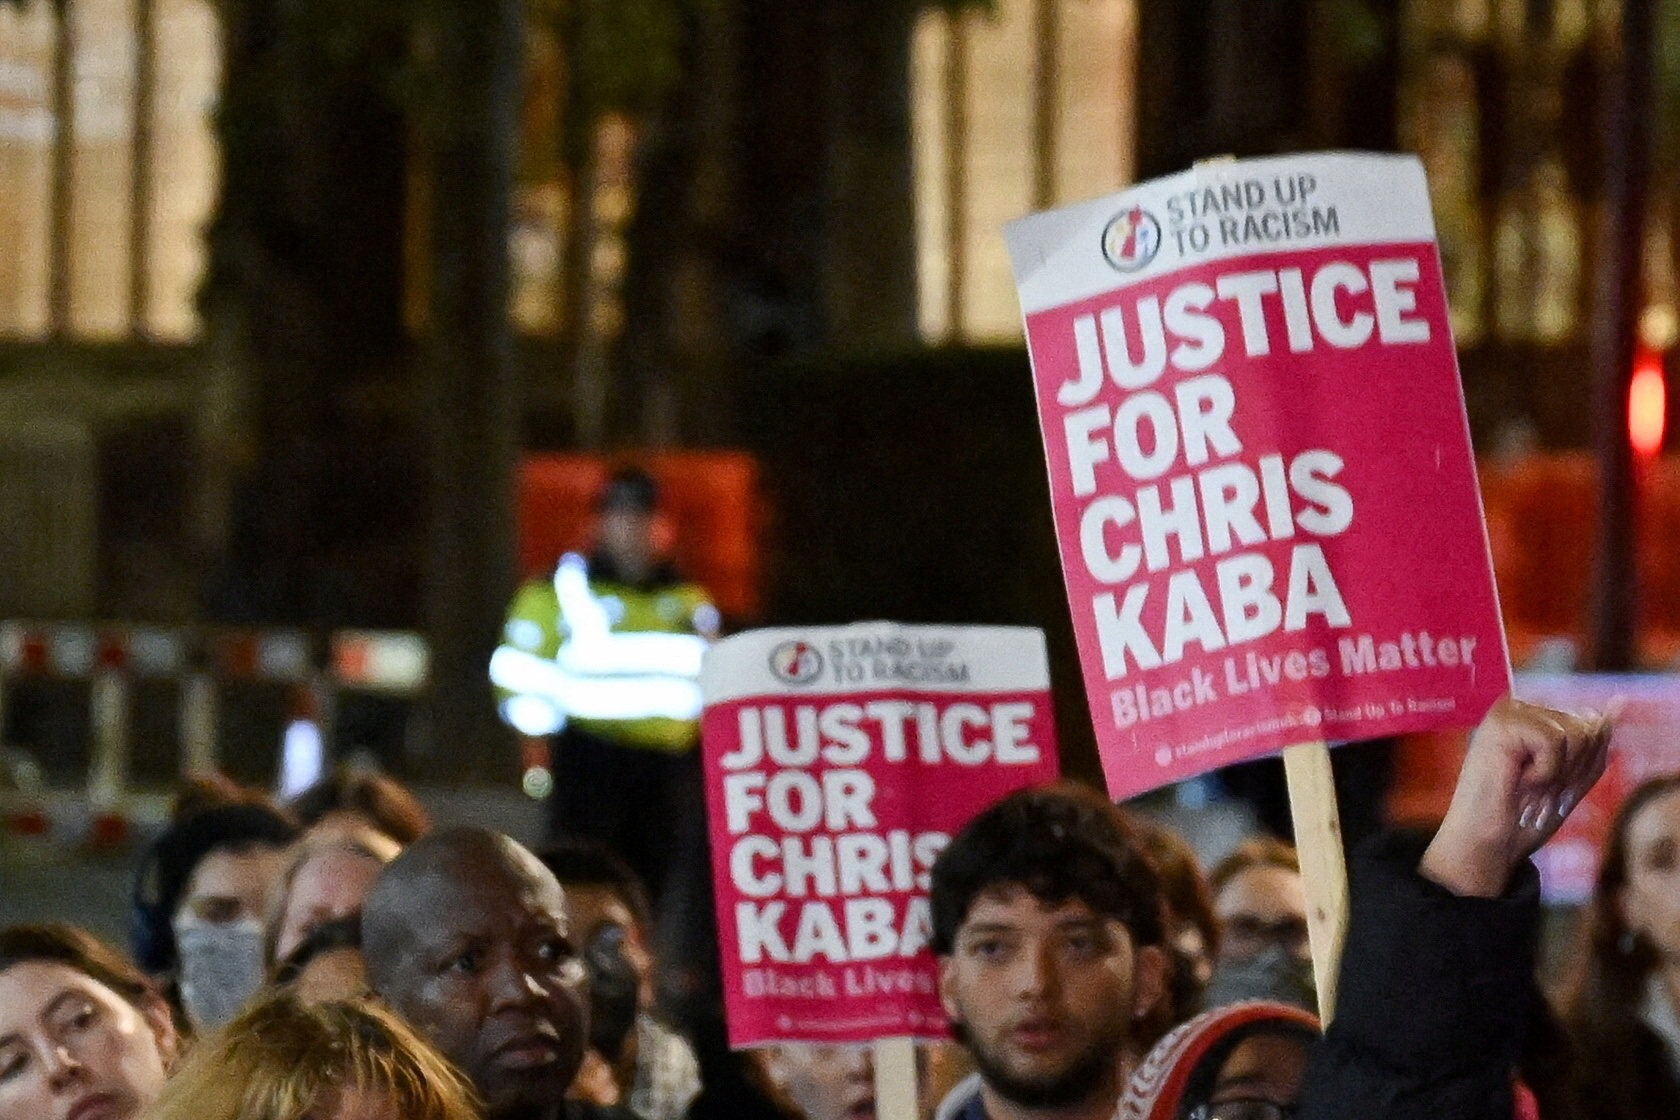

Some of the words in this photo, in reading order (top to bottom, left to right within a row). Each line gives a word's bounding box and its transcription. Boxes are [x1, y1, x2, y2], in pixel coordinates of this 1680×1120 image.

[1167, 178, 1265, 223] STAND
[1274, 172, 1317, 206] UP
[1171, 222, 1209, 256] TO
[1219, 205, 1341, 245] RACISM
[1056, 258, 1431, 406] JUSTICE
[1063, 373, 1242, 497] FOR
[1079, 450, 1354, 584] CHRIS
[1092, 543, 1352, 681] KABA
[1110, 667, 1217, 728] Black
[1224, 647, 1330, 696] Lives
[1338, 631, 1477, 677] Matter
[720, 700, 1040, 770] JUSTICE
[723, 767, 878, 834] FOR
[730, 829, 952, 897] CHRIS
[735, 896, 935, 963] KABA
[743, 967, 836, 998] Black
